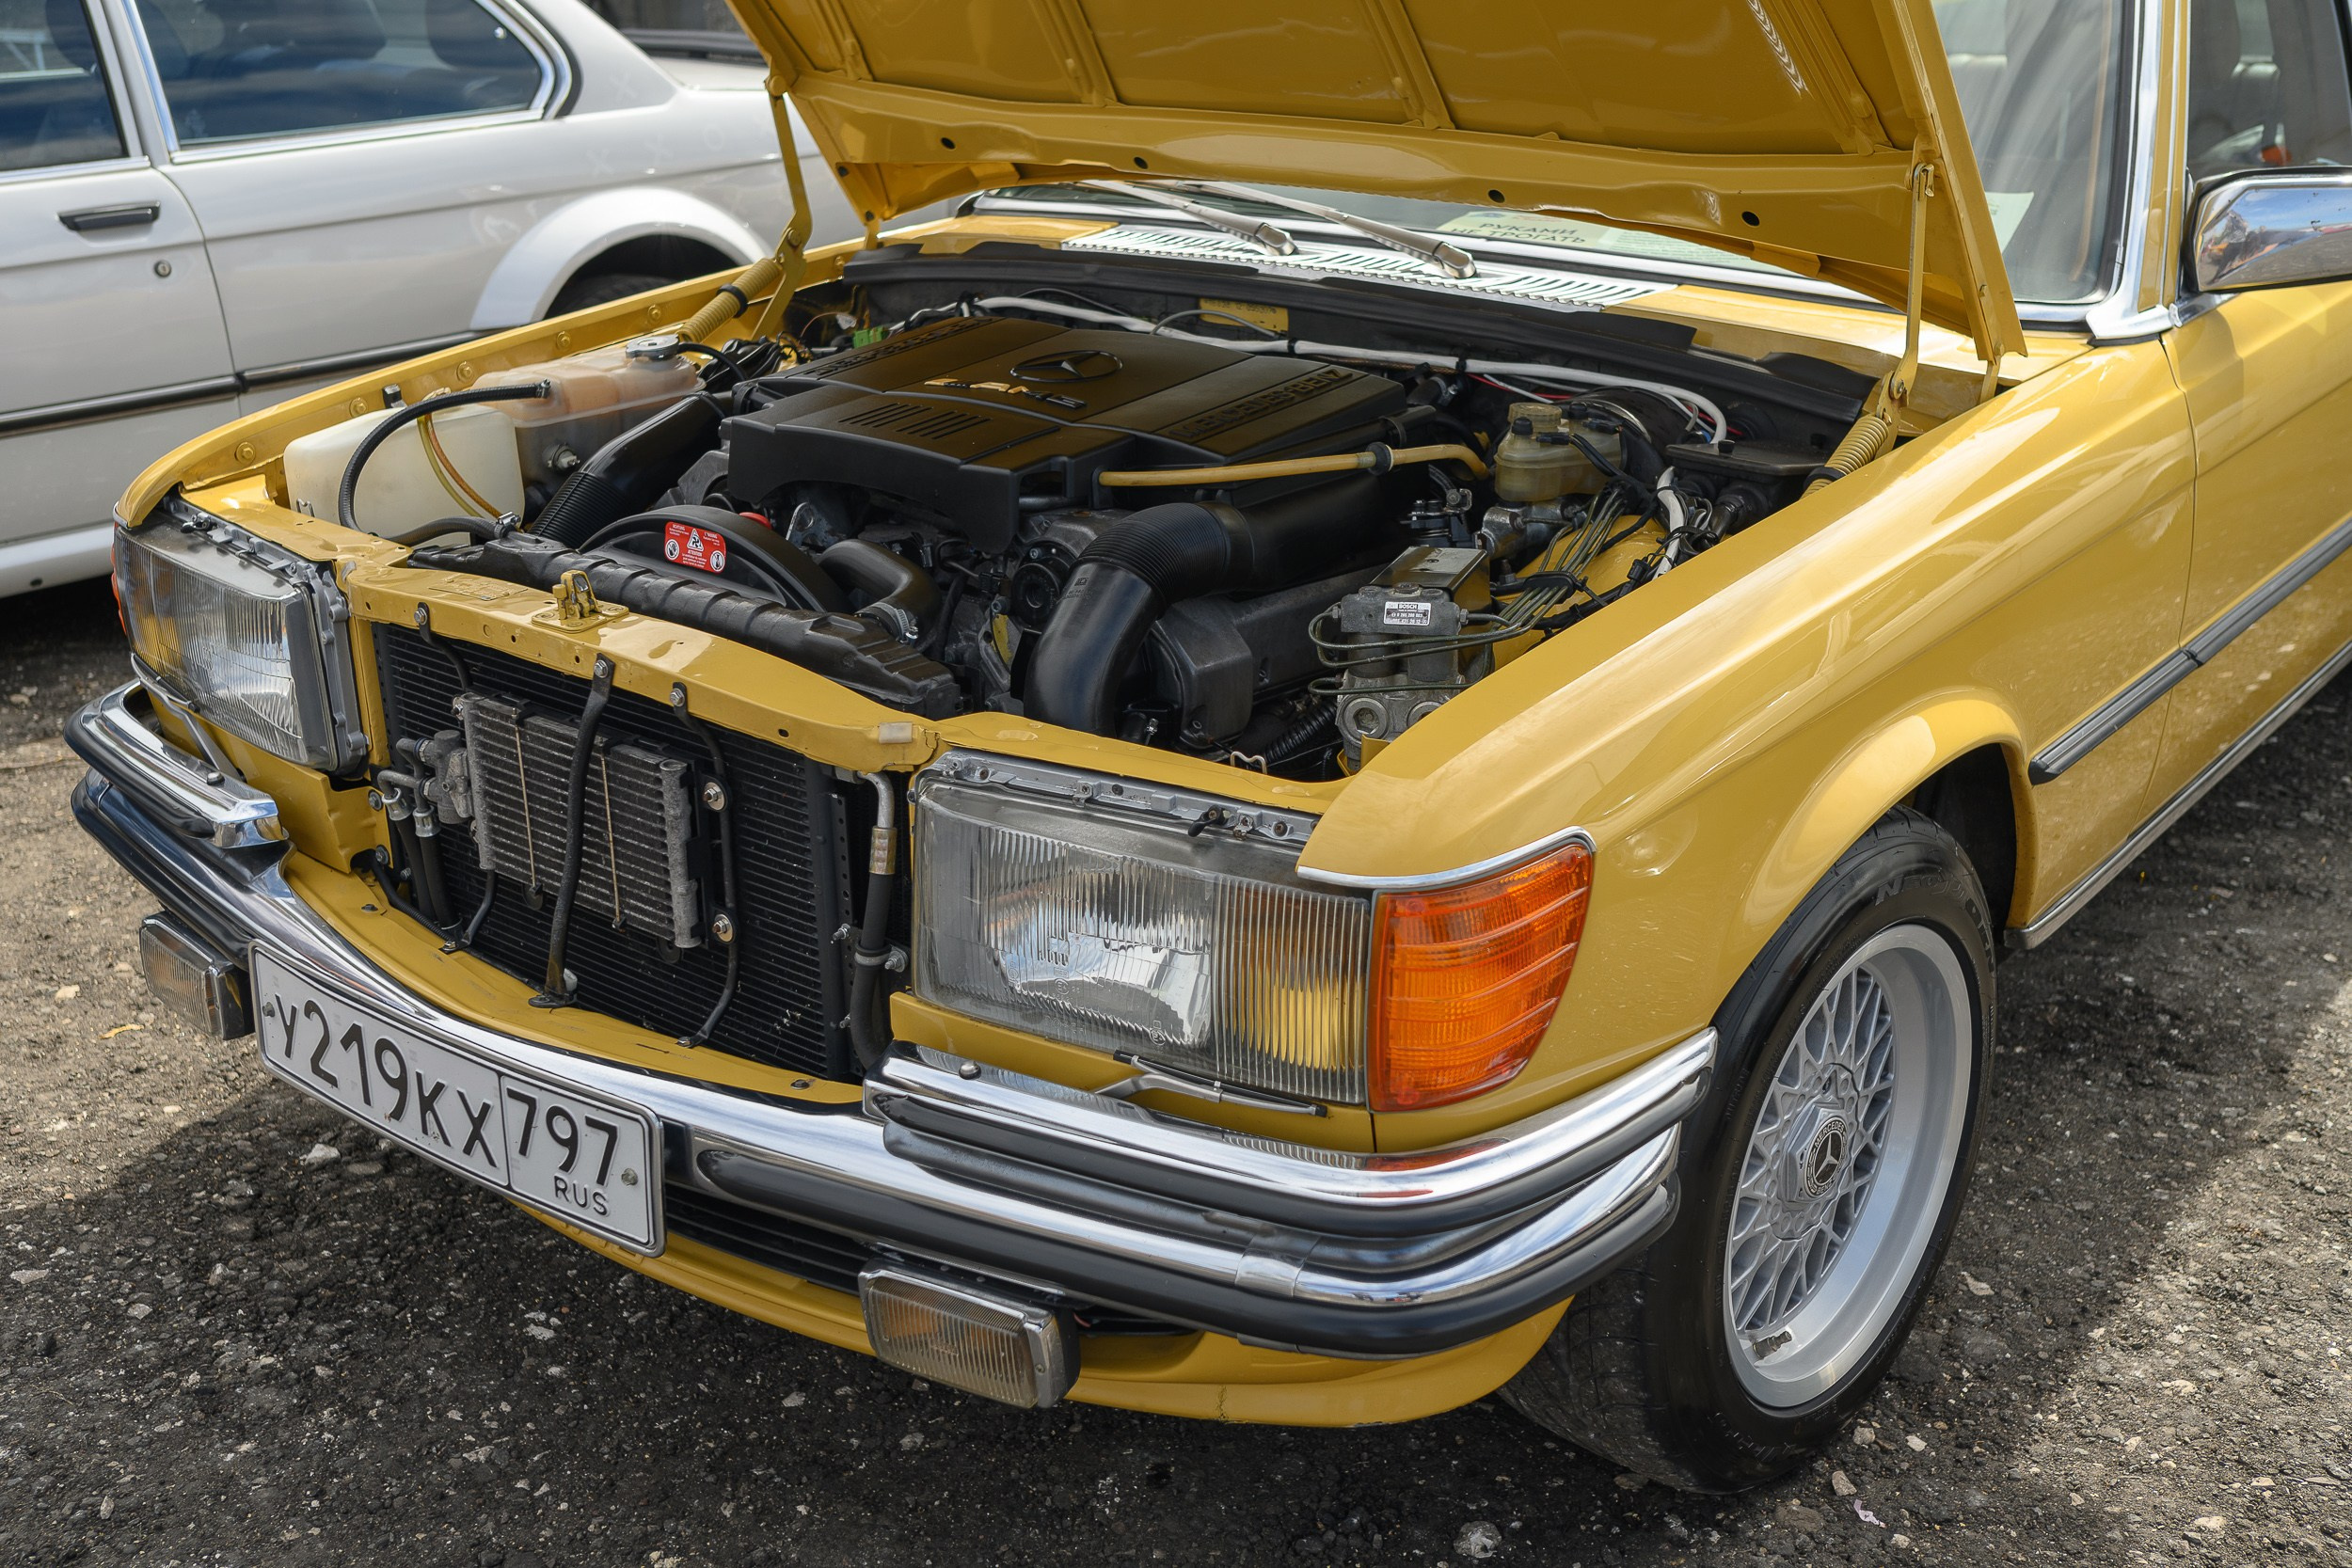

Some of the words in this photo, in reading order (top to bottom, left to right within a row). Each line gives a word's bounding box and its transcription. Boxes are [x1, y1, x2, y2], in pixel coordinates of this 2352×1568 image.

[1479, 223, 1578, 235] РУКАМИ
[1489, 231, 1585, 244] ТРОГАТЬ
[506, 1087, 619, 1186] 797
[1814, 1121, 1845, 1148] MERCEDES
[553, 1178, 610, 1216] RUS
[1816, 1180, 1833, 1195] BENZ
